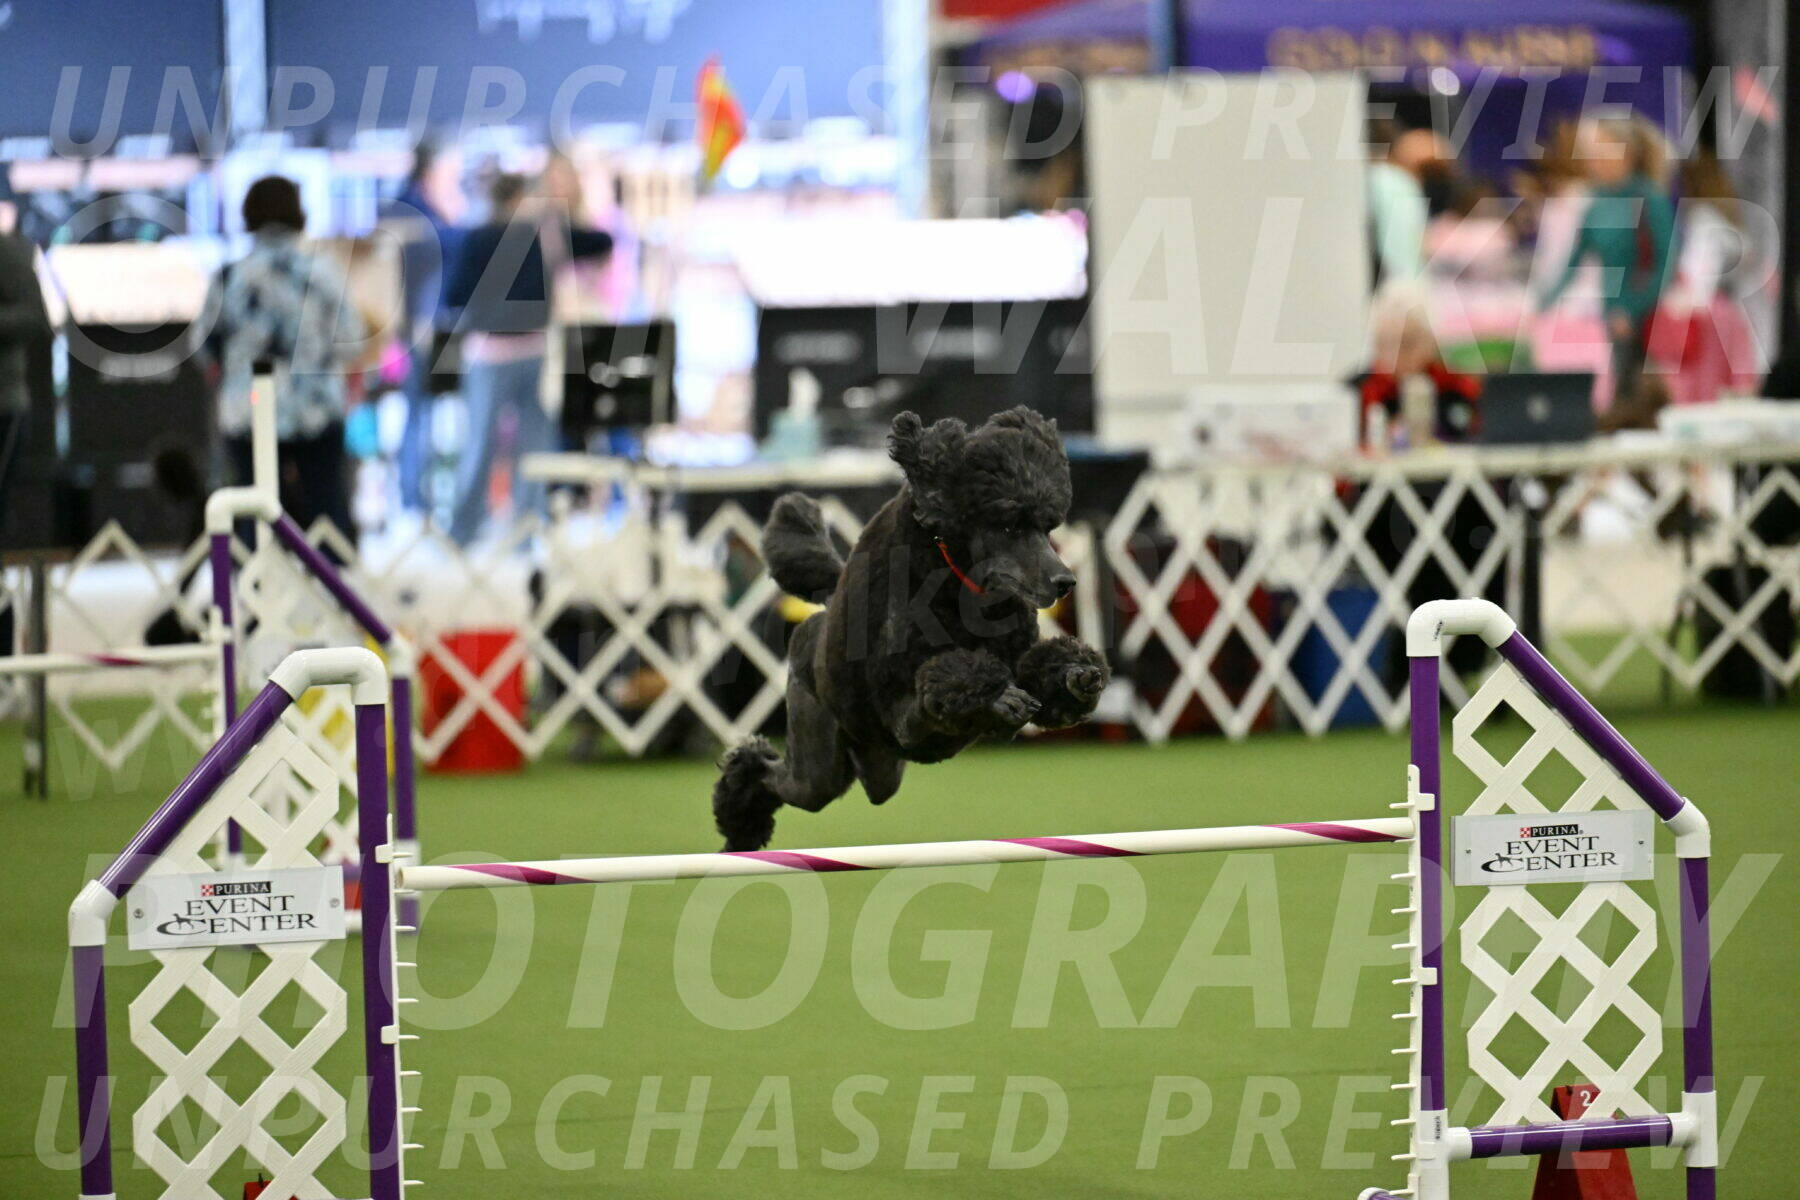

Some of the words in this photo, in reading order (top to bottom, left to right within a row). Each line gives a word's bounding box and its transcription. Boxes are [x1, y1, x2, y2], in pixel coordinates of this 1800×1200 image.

[1532, 824, 1578, 837] PURINA
[1505, 836, 1600, 856] EVENT
[1480, 851, 1619, 873] CENTER
[216, 881, 270, 896] PURINA
[185, 894, 295, 916] EVENT
[156, 912, 318, 936] CENTER
[1580, 1090, 1592, 1107] 2
